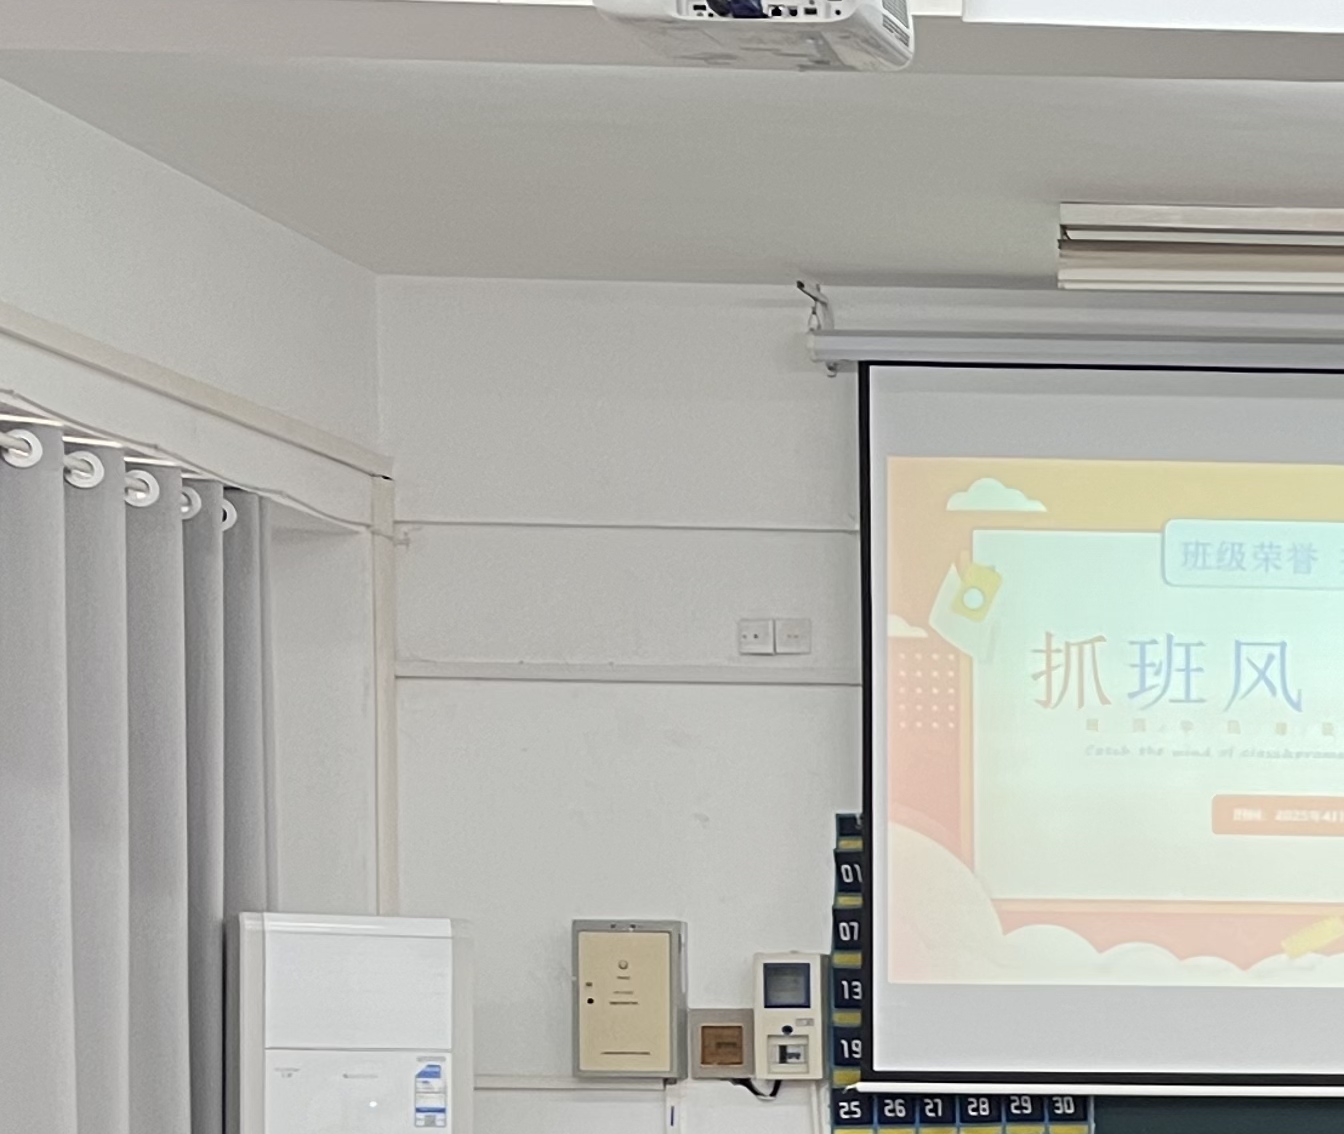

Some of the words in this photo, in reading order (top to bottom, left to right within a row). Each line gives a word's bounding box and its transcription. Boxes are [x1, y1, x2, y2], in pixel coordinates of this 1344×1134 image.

[1180, 540, 1319, 576] 班级荣誉
[1031, 631, 1302, 713] 抓班风
[841, 864, 862, 882] 01
[839, 922, 858, 940] 07
[842, 981, 861, 999] 13
[841, 1040, 861, 1058] 19
[839, 1102, 861, 1118] 25
[885, 1099, 905, 1117] 26
[925, 1099, 941, 1116] 27
[968, 1098, 989, 1115] 28
[1011, 1097, 1031, 1113] 29
[1053, 1097, 1074, 1113] 30
